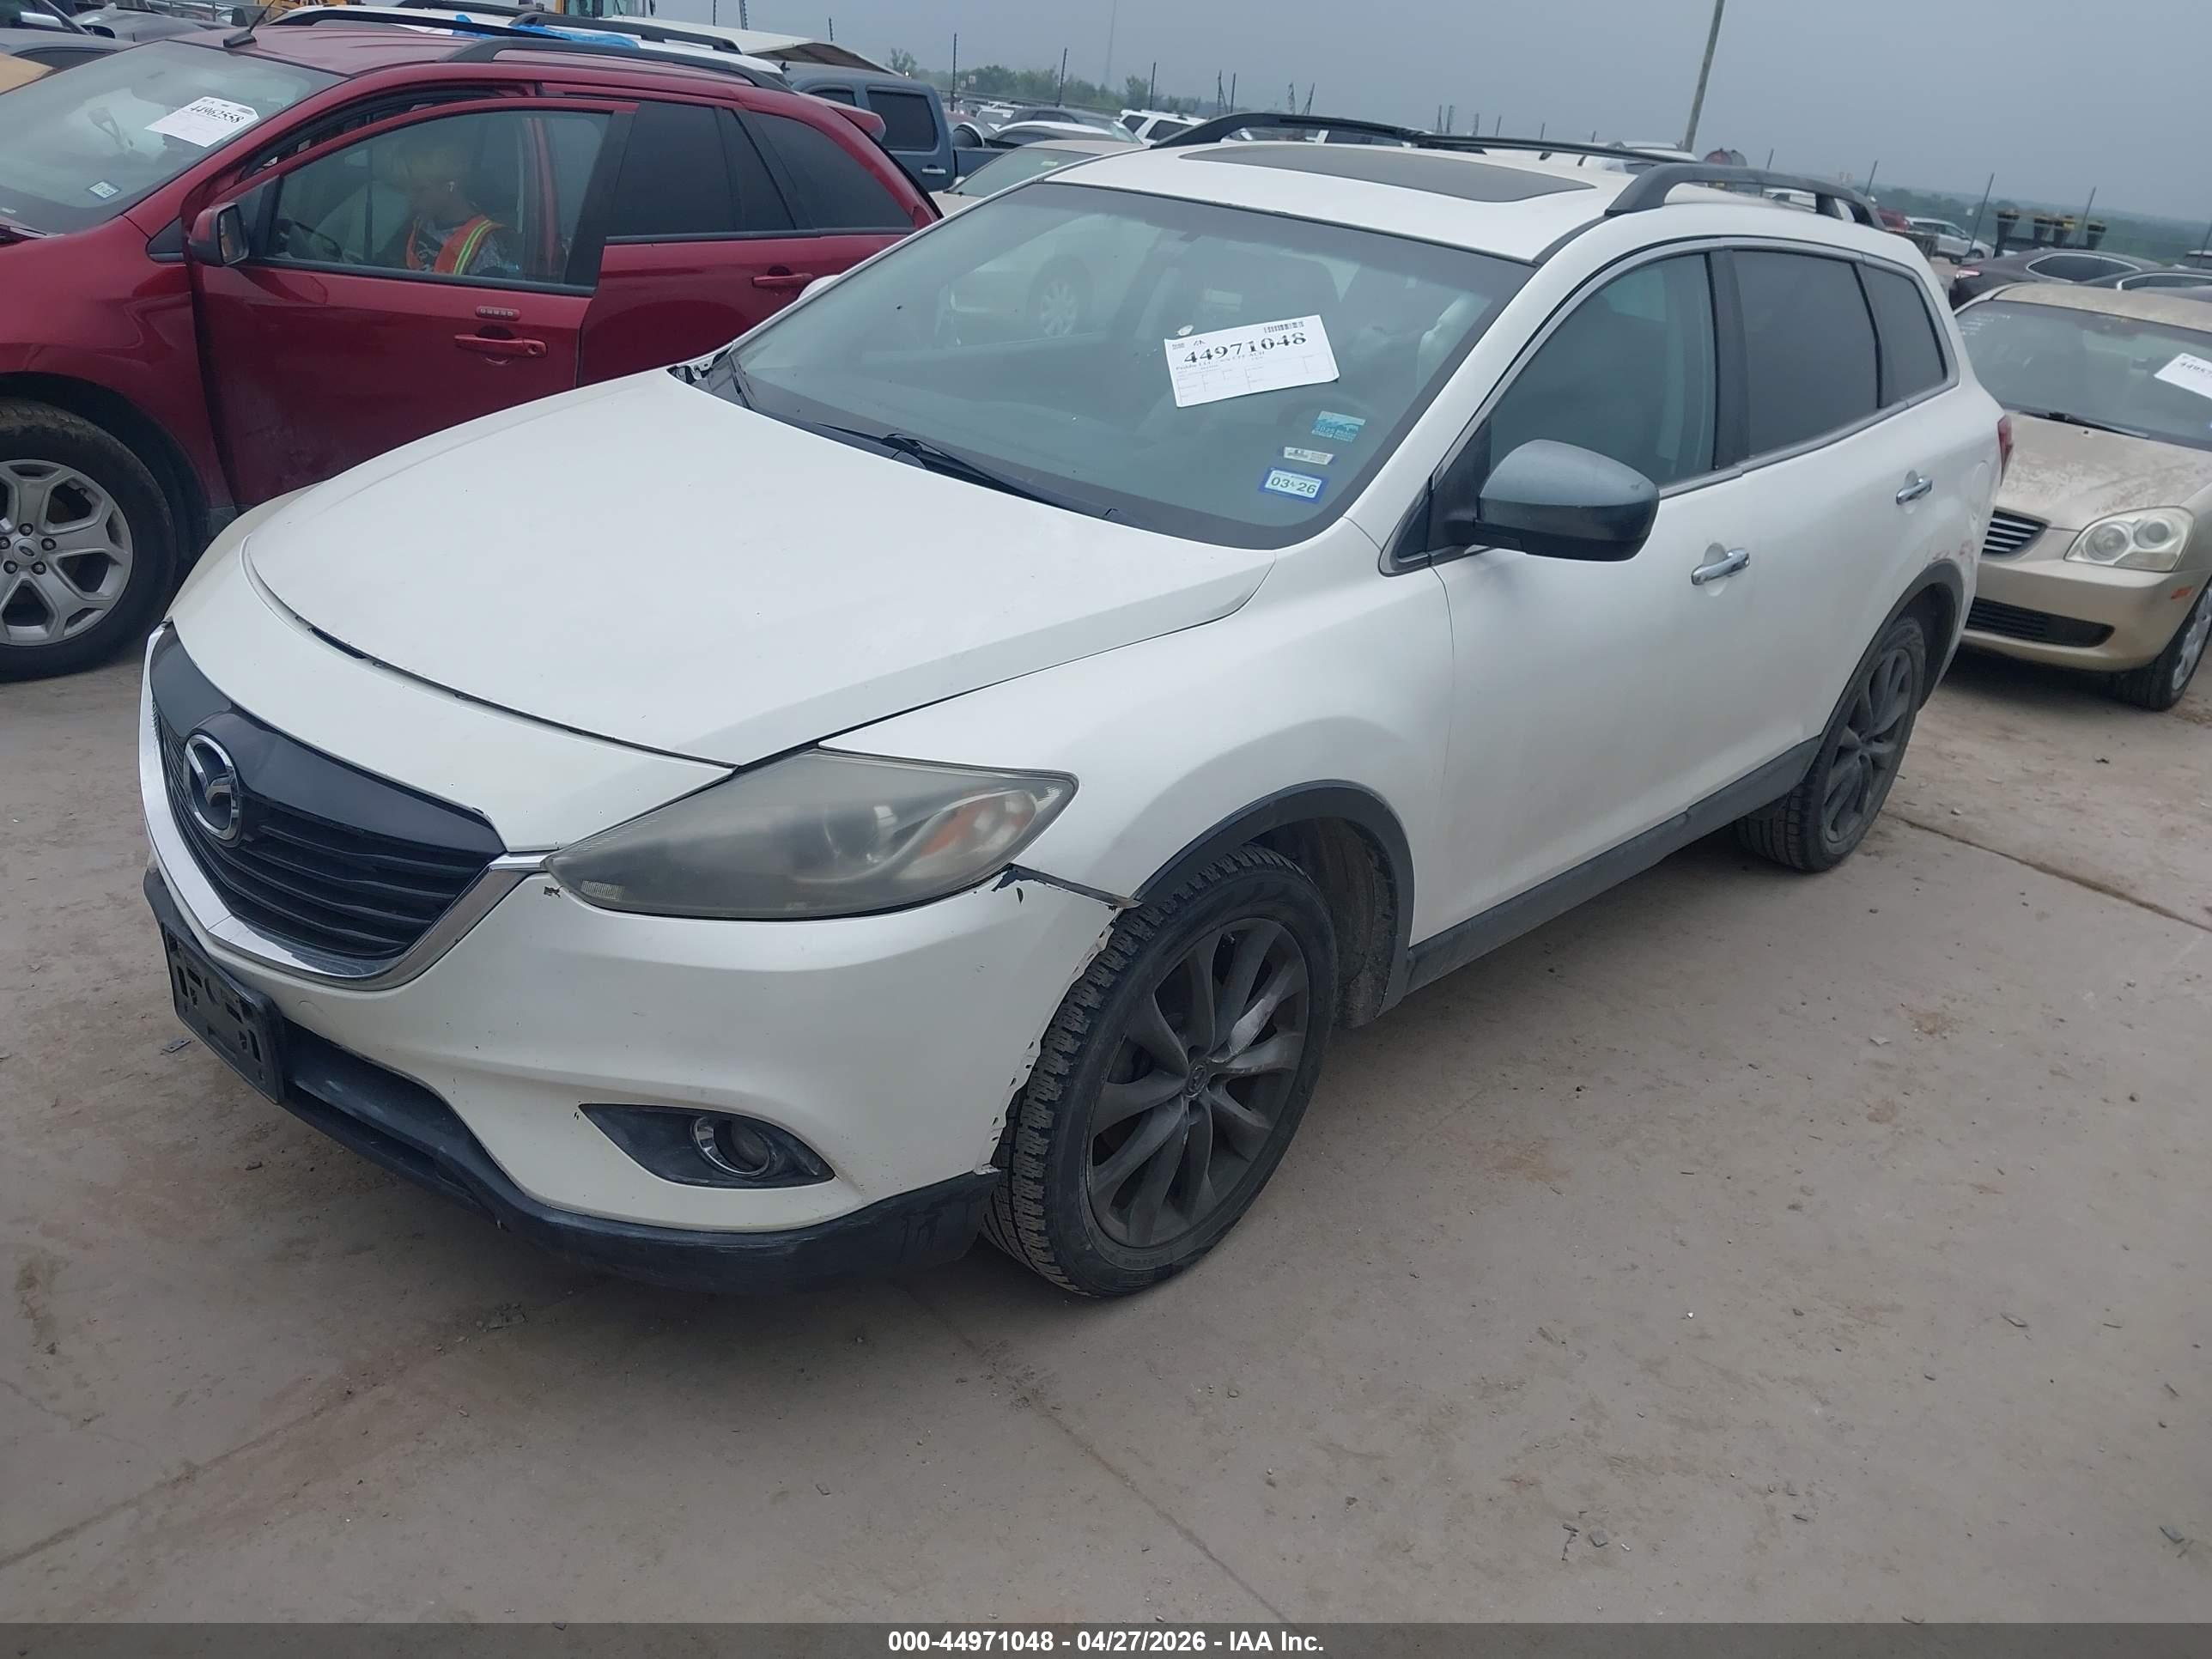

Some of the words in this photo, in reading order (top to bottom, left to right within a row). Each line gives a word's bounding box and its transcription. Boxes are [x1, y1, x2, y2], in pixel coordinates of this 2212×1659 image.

[190, 105, 245, 124] 44962558
[1183, 332, 1307, 364] 44971048
[1271, 477, 1290, 489] 03
[1297, 482, 1317, 495] 26
